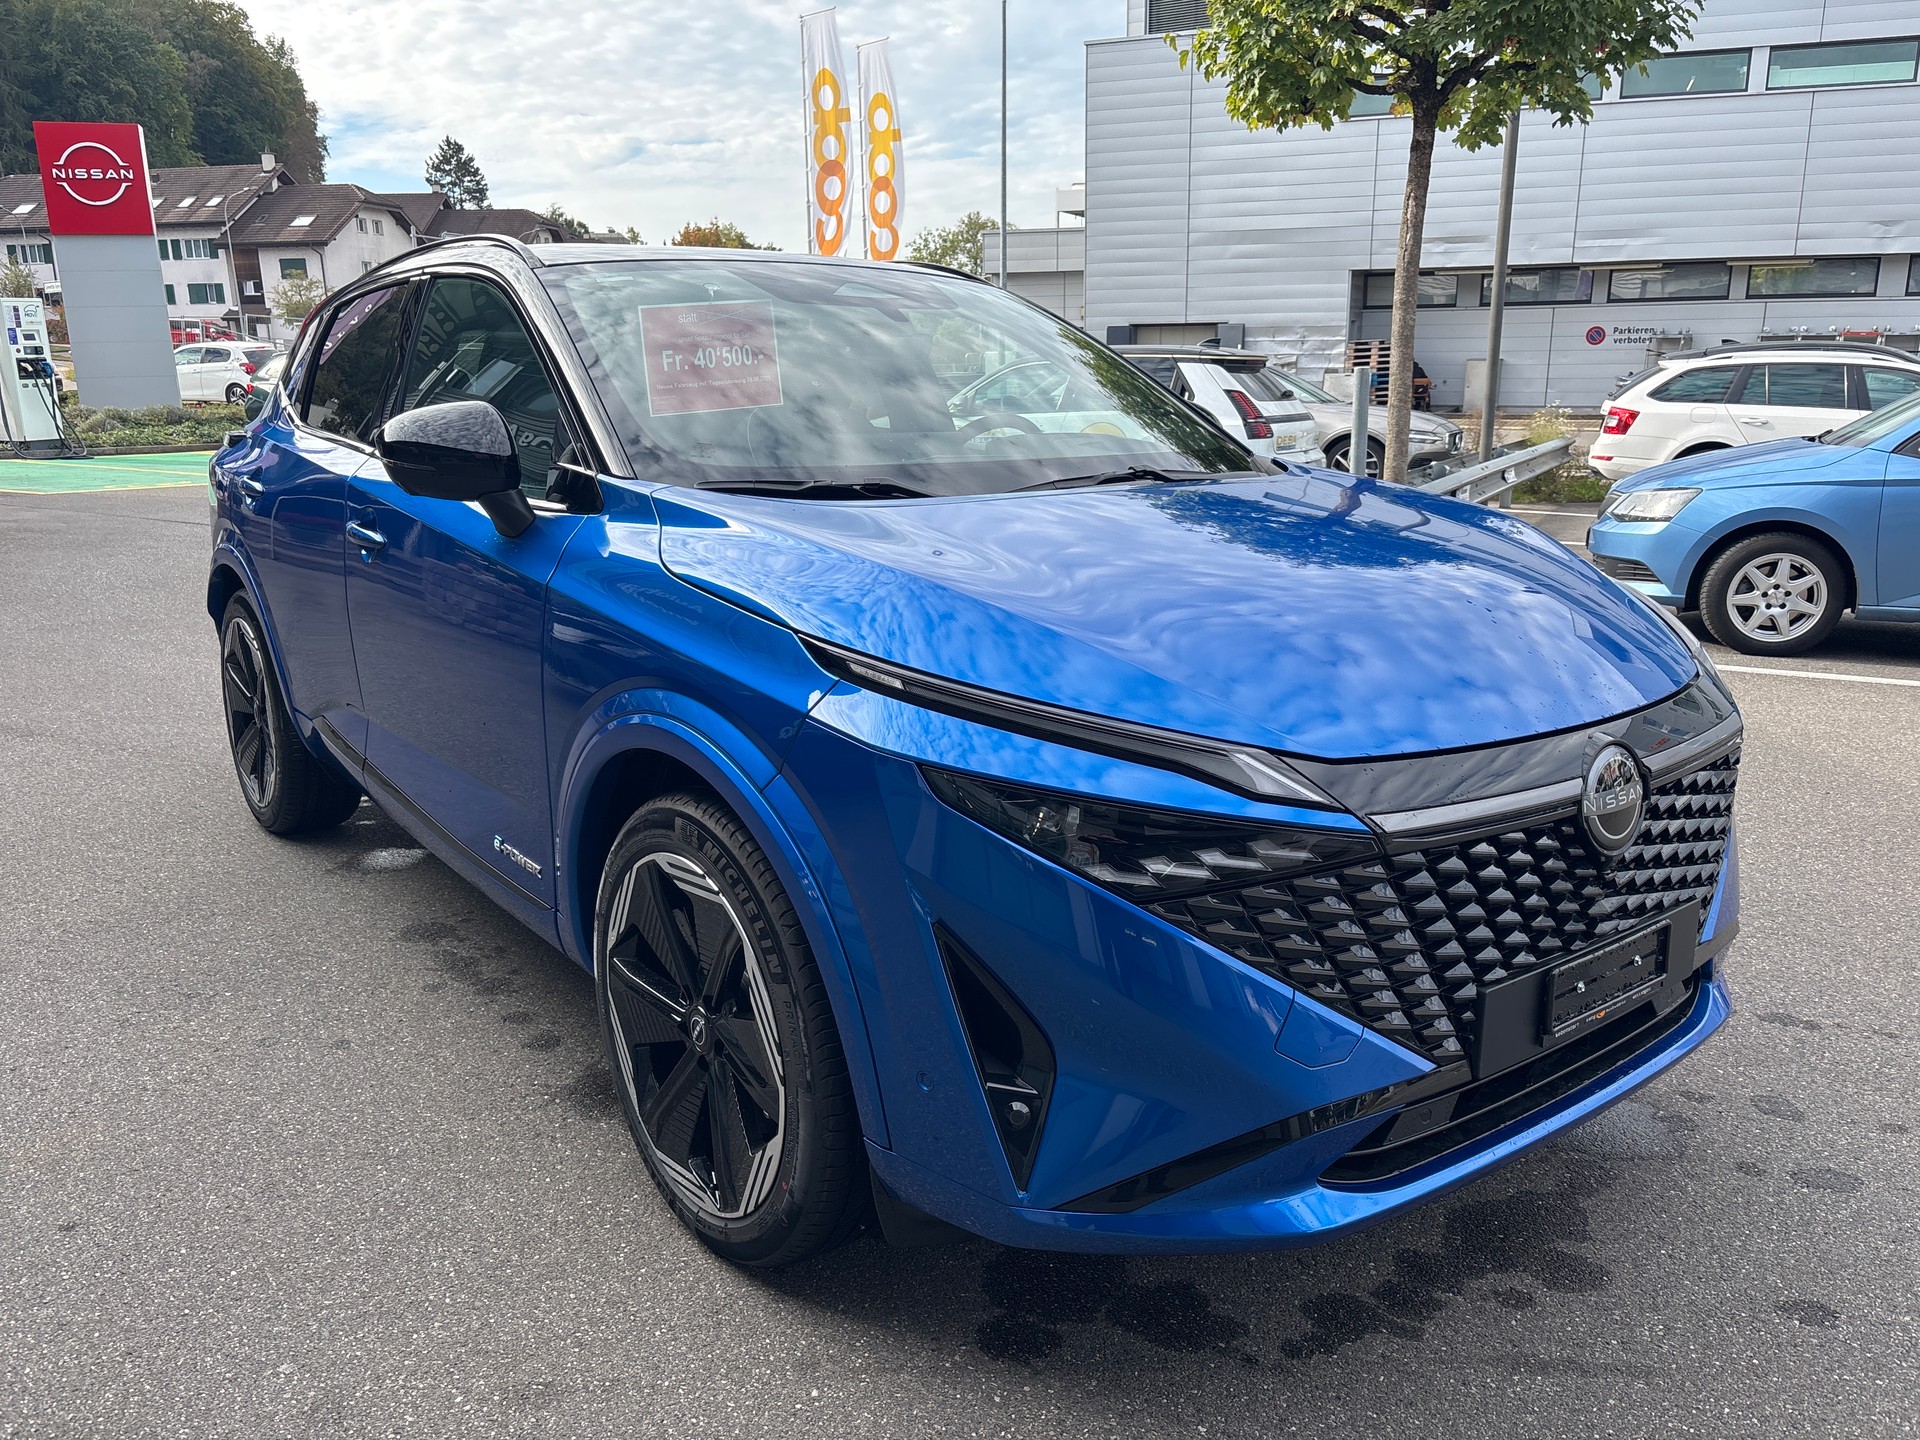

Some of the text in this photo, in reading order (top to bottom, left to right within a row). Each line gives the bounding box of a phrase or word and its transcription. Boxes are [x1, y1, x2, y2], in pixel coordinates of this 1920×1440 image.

[52, 168, 134, 180] NISSAN
[1613, 326, 1655, 335] Parkieren
[661, 350, 689, 372] Fr.
[1583, 784, 1643, 813] NISSAN
[701, 841, 785, 976] MICHELIN
